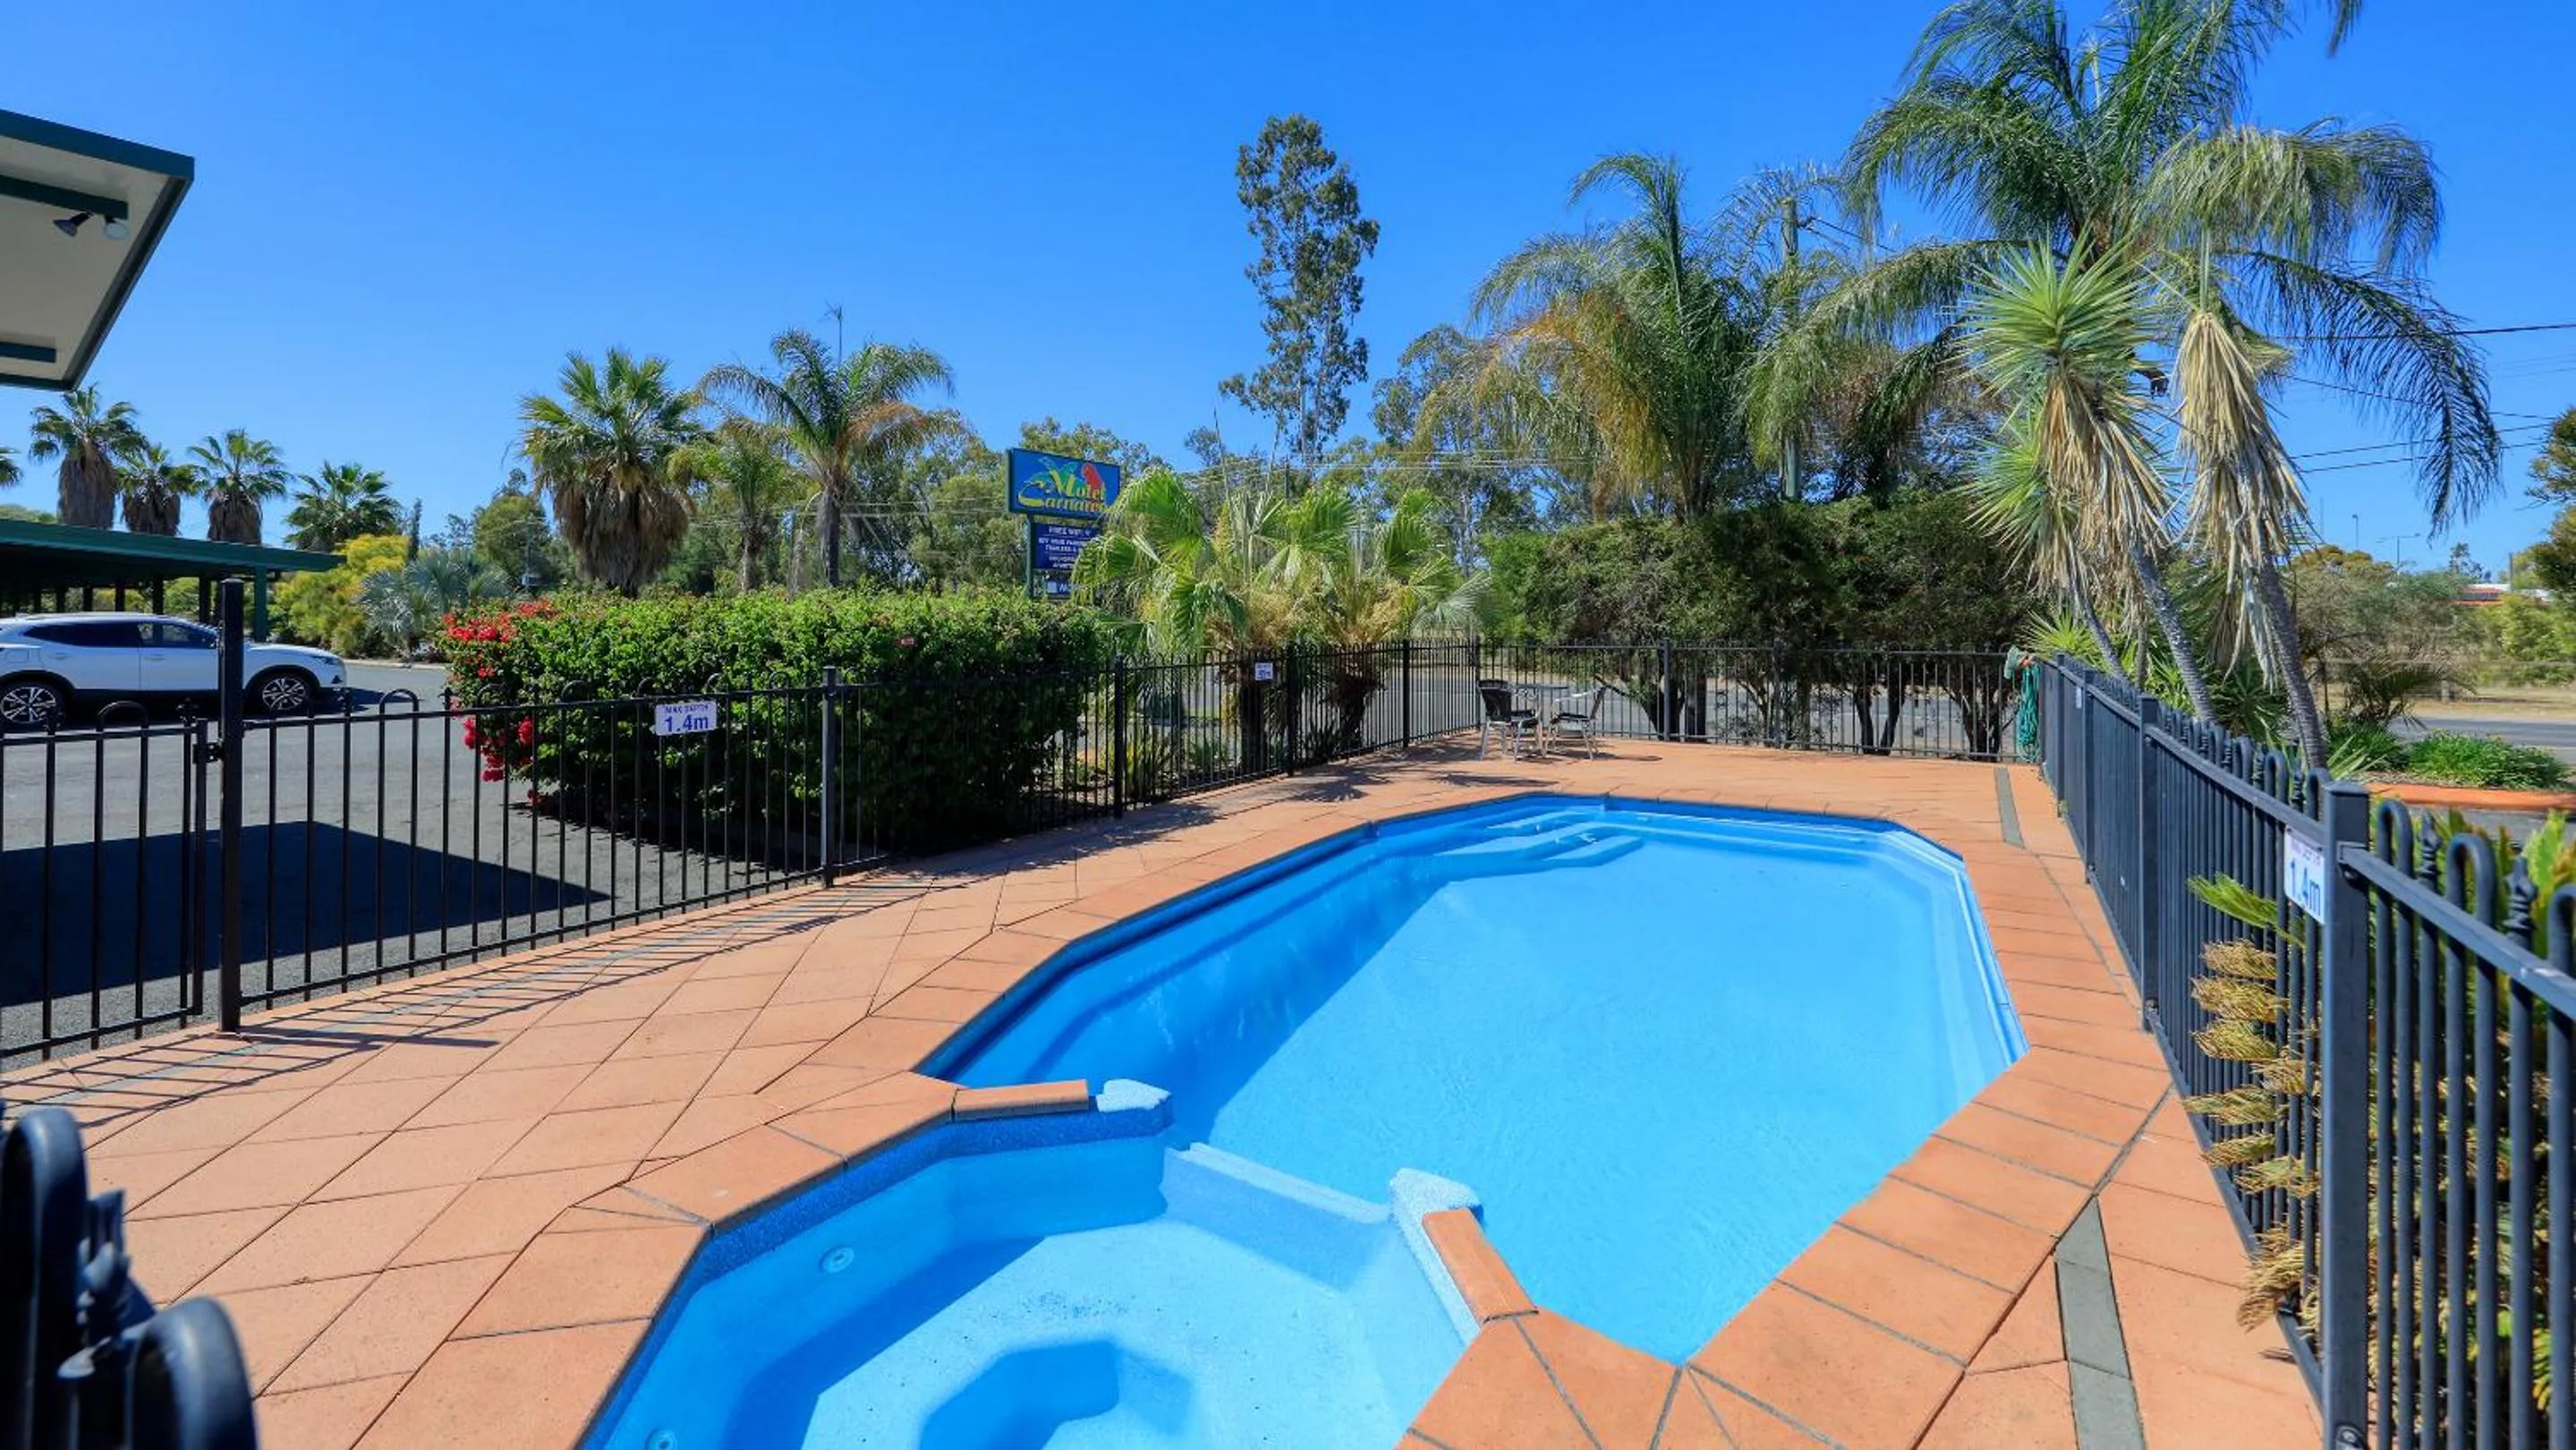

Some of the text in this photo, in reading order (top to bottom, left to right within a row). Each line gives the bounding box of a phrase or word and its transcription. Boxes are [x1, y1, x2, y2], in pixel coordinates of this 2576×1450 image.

[1044, 469, 1106, 500] Motel
[665, 714, 709, 732] 1.4m
[2291, 859, 2321, 917] 1.4m
